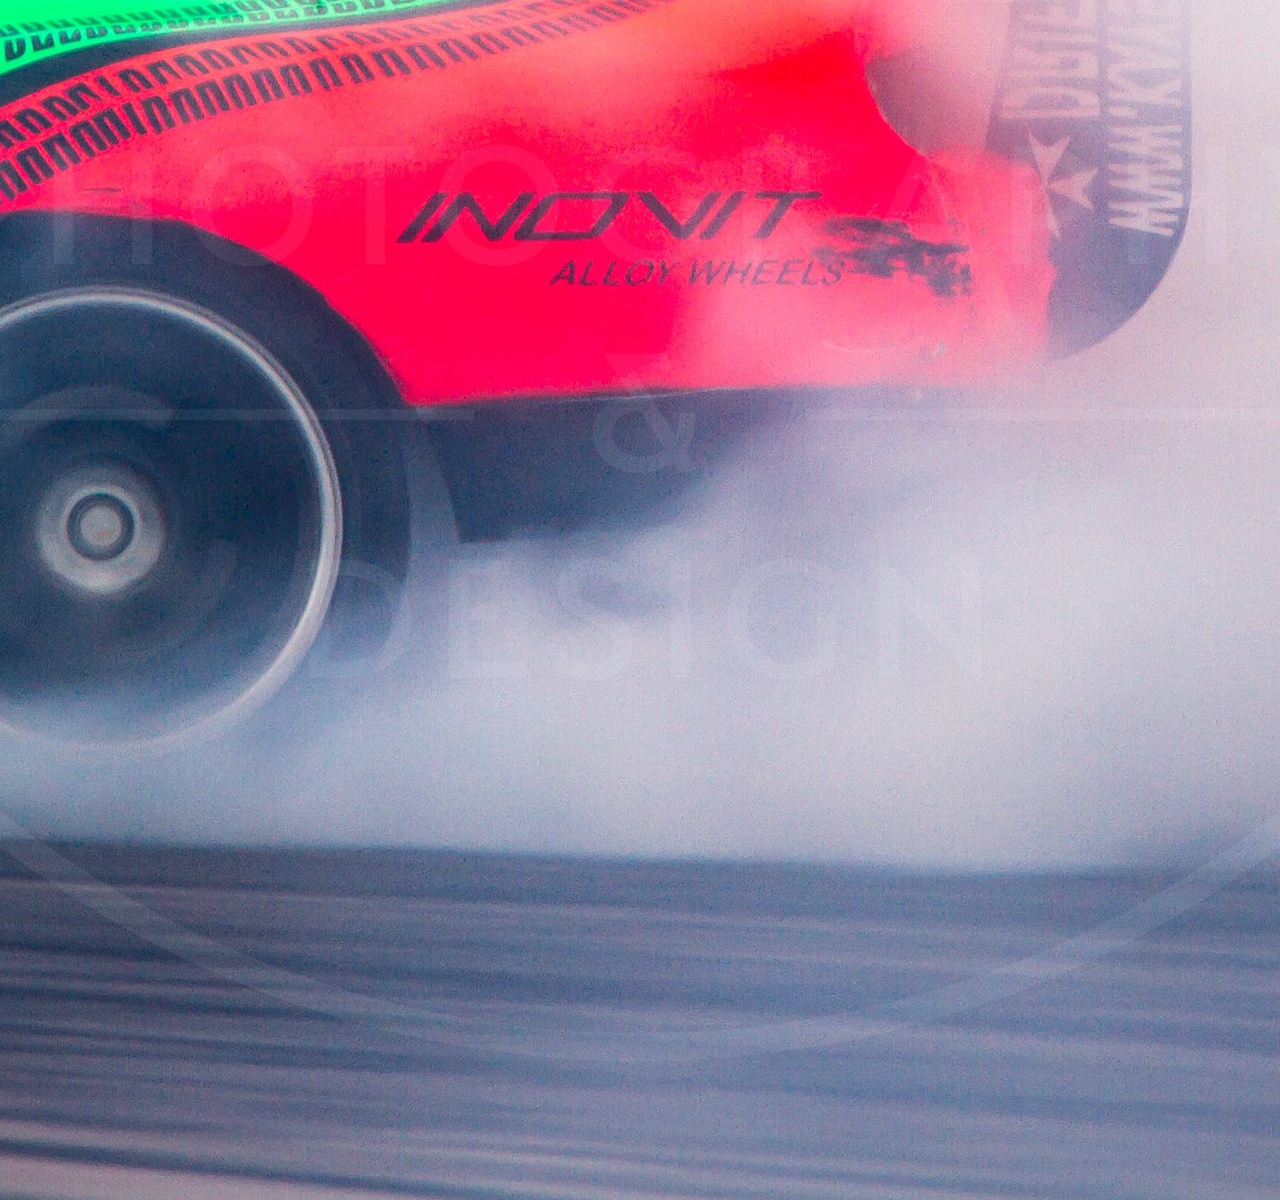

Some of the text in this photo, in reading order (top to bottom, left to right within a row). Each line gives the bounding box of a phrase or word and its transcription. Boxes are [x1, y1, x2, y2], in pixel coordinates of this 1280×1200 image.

[396, 190, 821, 244] INOVIT
[549, 258, 846, 287] ALLOY WHEELS
